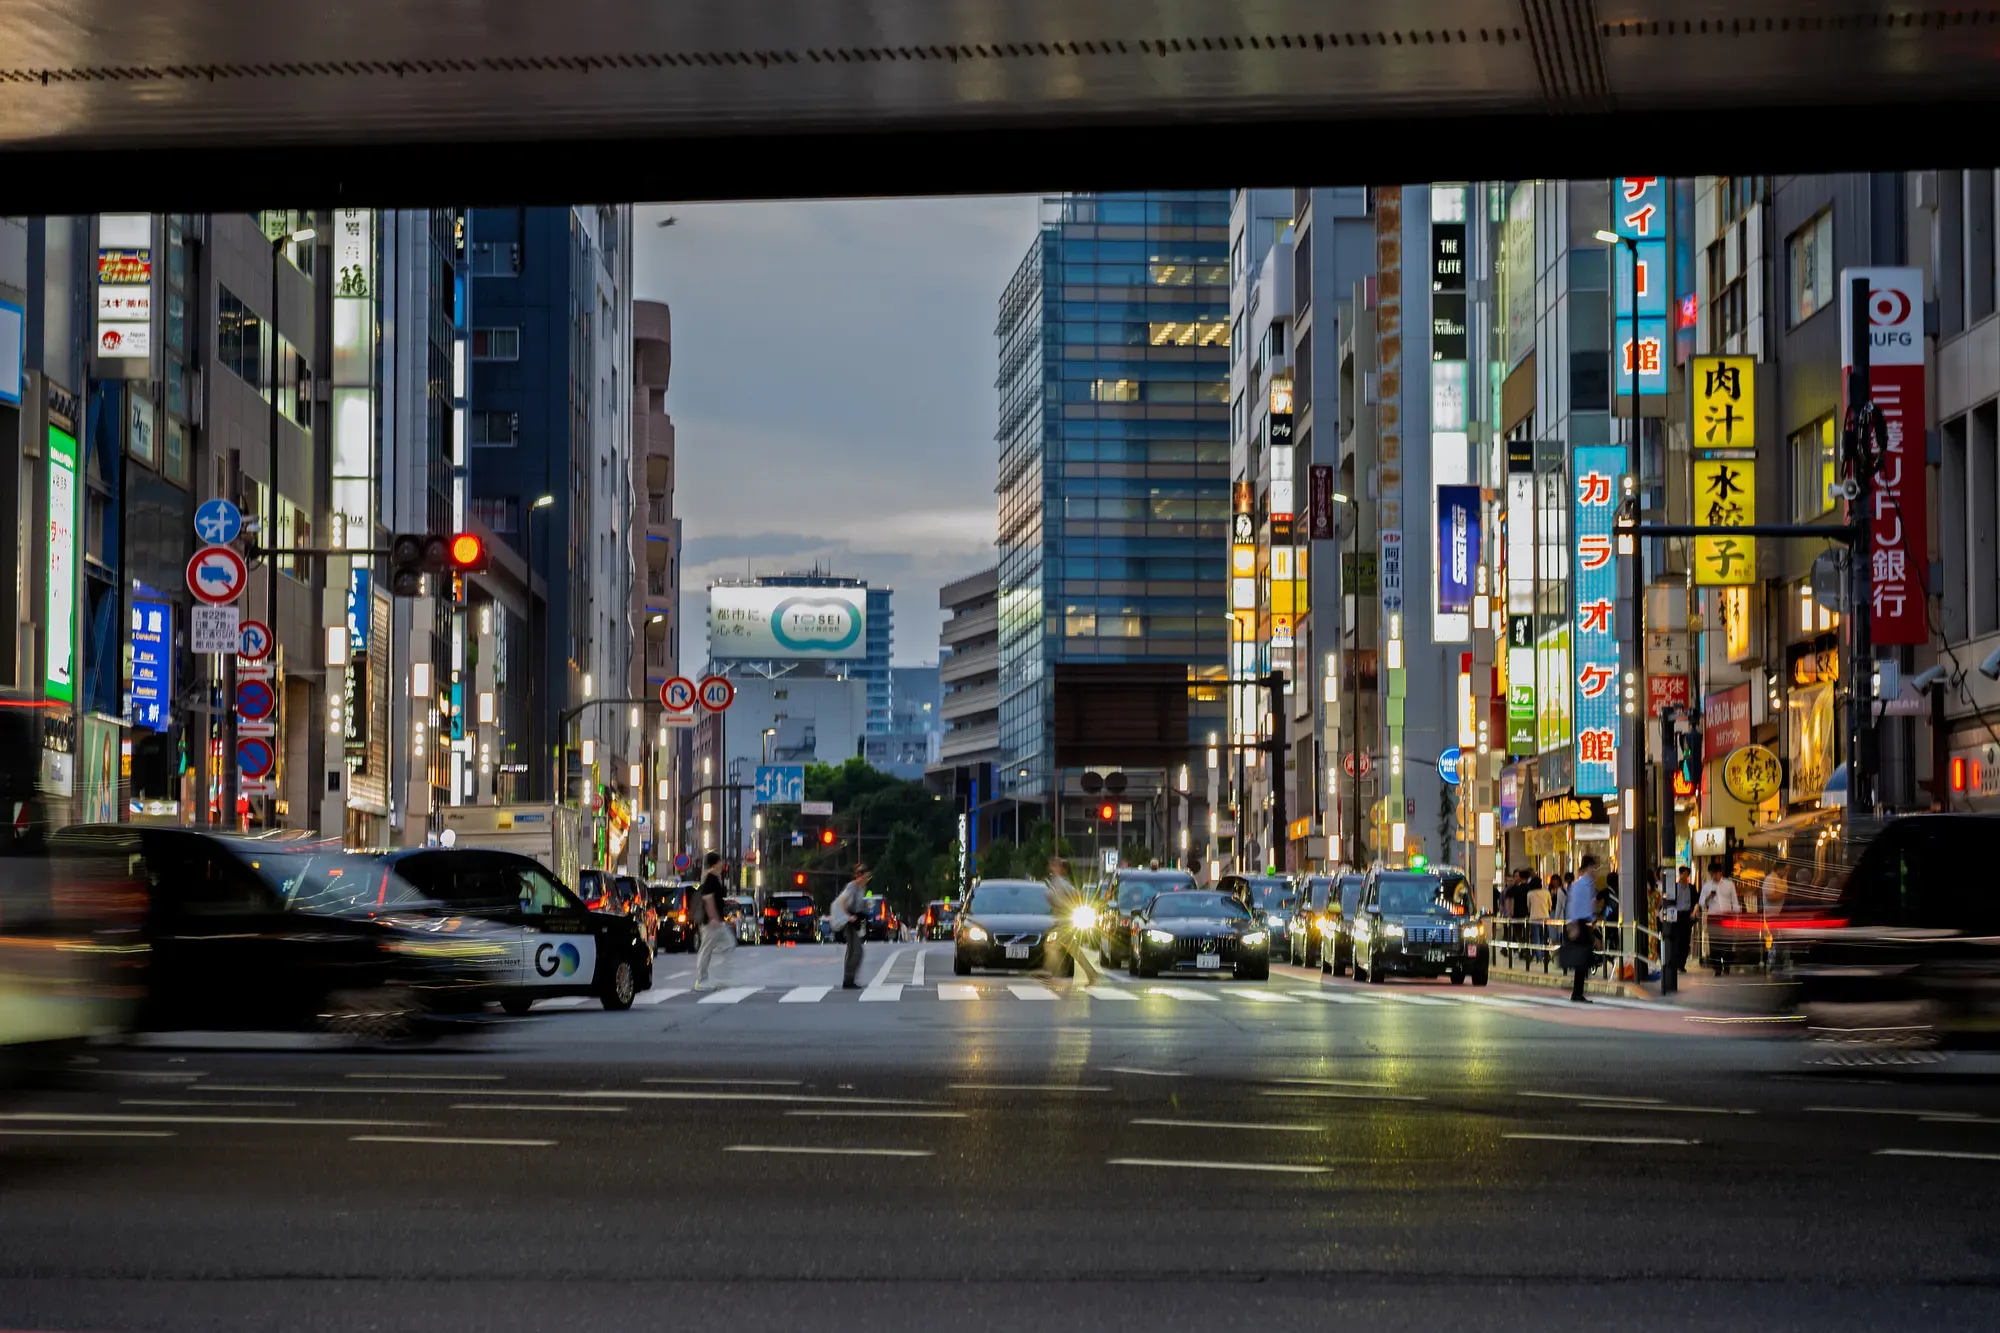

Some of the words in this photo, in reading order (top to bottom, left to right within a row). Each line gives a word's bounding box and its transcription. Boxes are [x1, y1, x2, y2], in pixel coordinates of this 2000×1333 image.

[1440, 239, 1458, 253] THE
[1438, 260, 1461, 274] ELITE
[1435, 322, 1464, 335] Million
[1868, 331, 1912, 346] UFG
[1705, 361, 1744, 444] 肉汁
[347, 514, 364, 525] UX
[1705, 464, 1745, 580] 水餃子
[1384, 547, 1399, 588] 阿里山
[717, 608, 766, 623] 都市に、
[1579, 471, 1614, 764] カラオケ館
[716, 624, 752, 637] 心を。
[707, 686, 726, 702] 40
[1731, 701, 1748, 721] factory
[535, 942, 580, 977] GO
